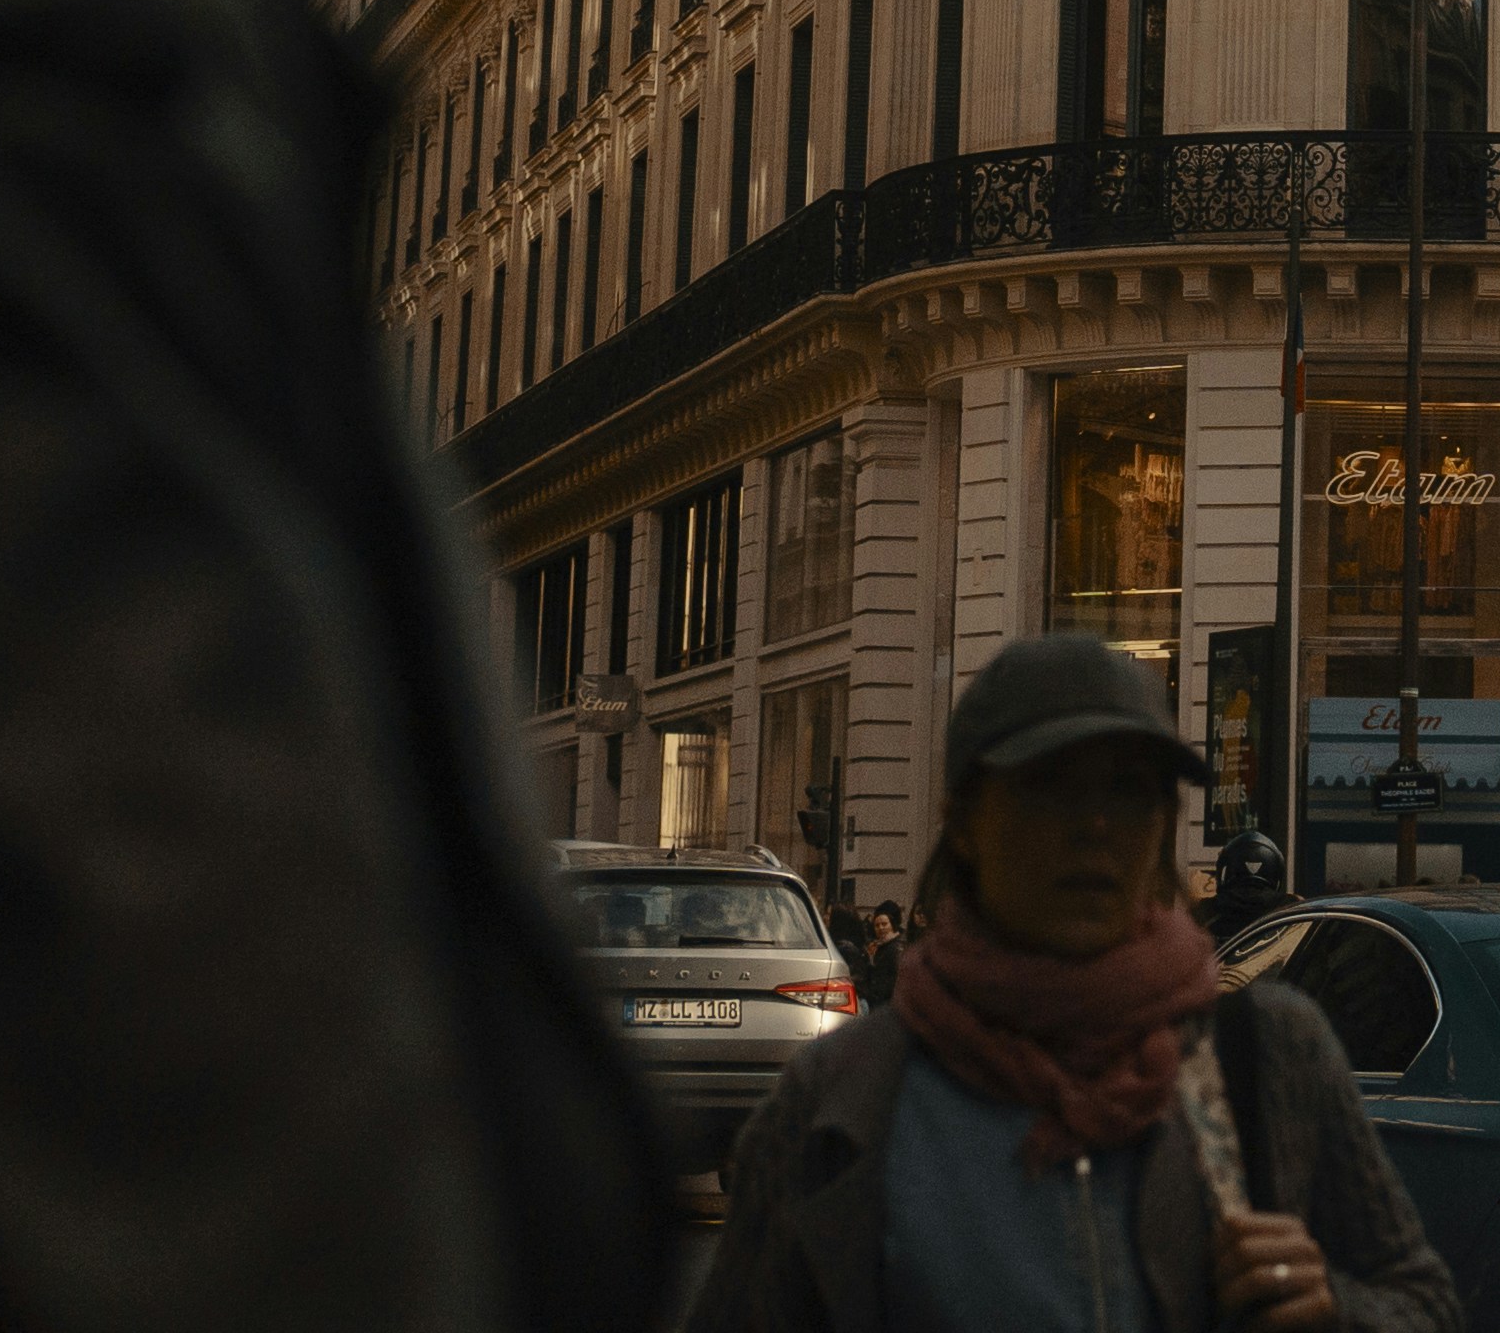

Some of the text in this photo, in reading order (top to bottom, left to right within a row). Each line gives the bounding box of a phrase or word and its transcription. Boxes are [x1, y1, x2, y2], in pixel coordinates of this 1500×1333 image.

[1325, 450, 1496, 505] Etam
[582, 697, 628, 711] Etam
[635, 1000, 739, 1019] MZ LL 1108
